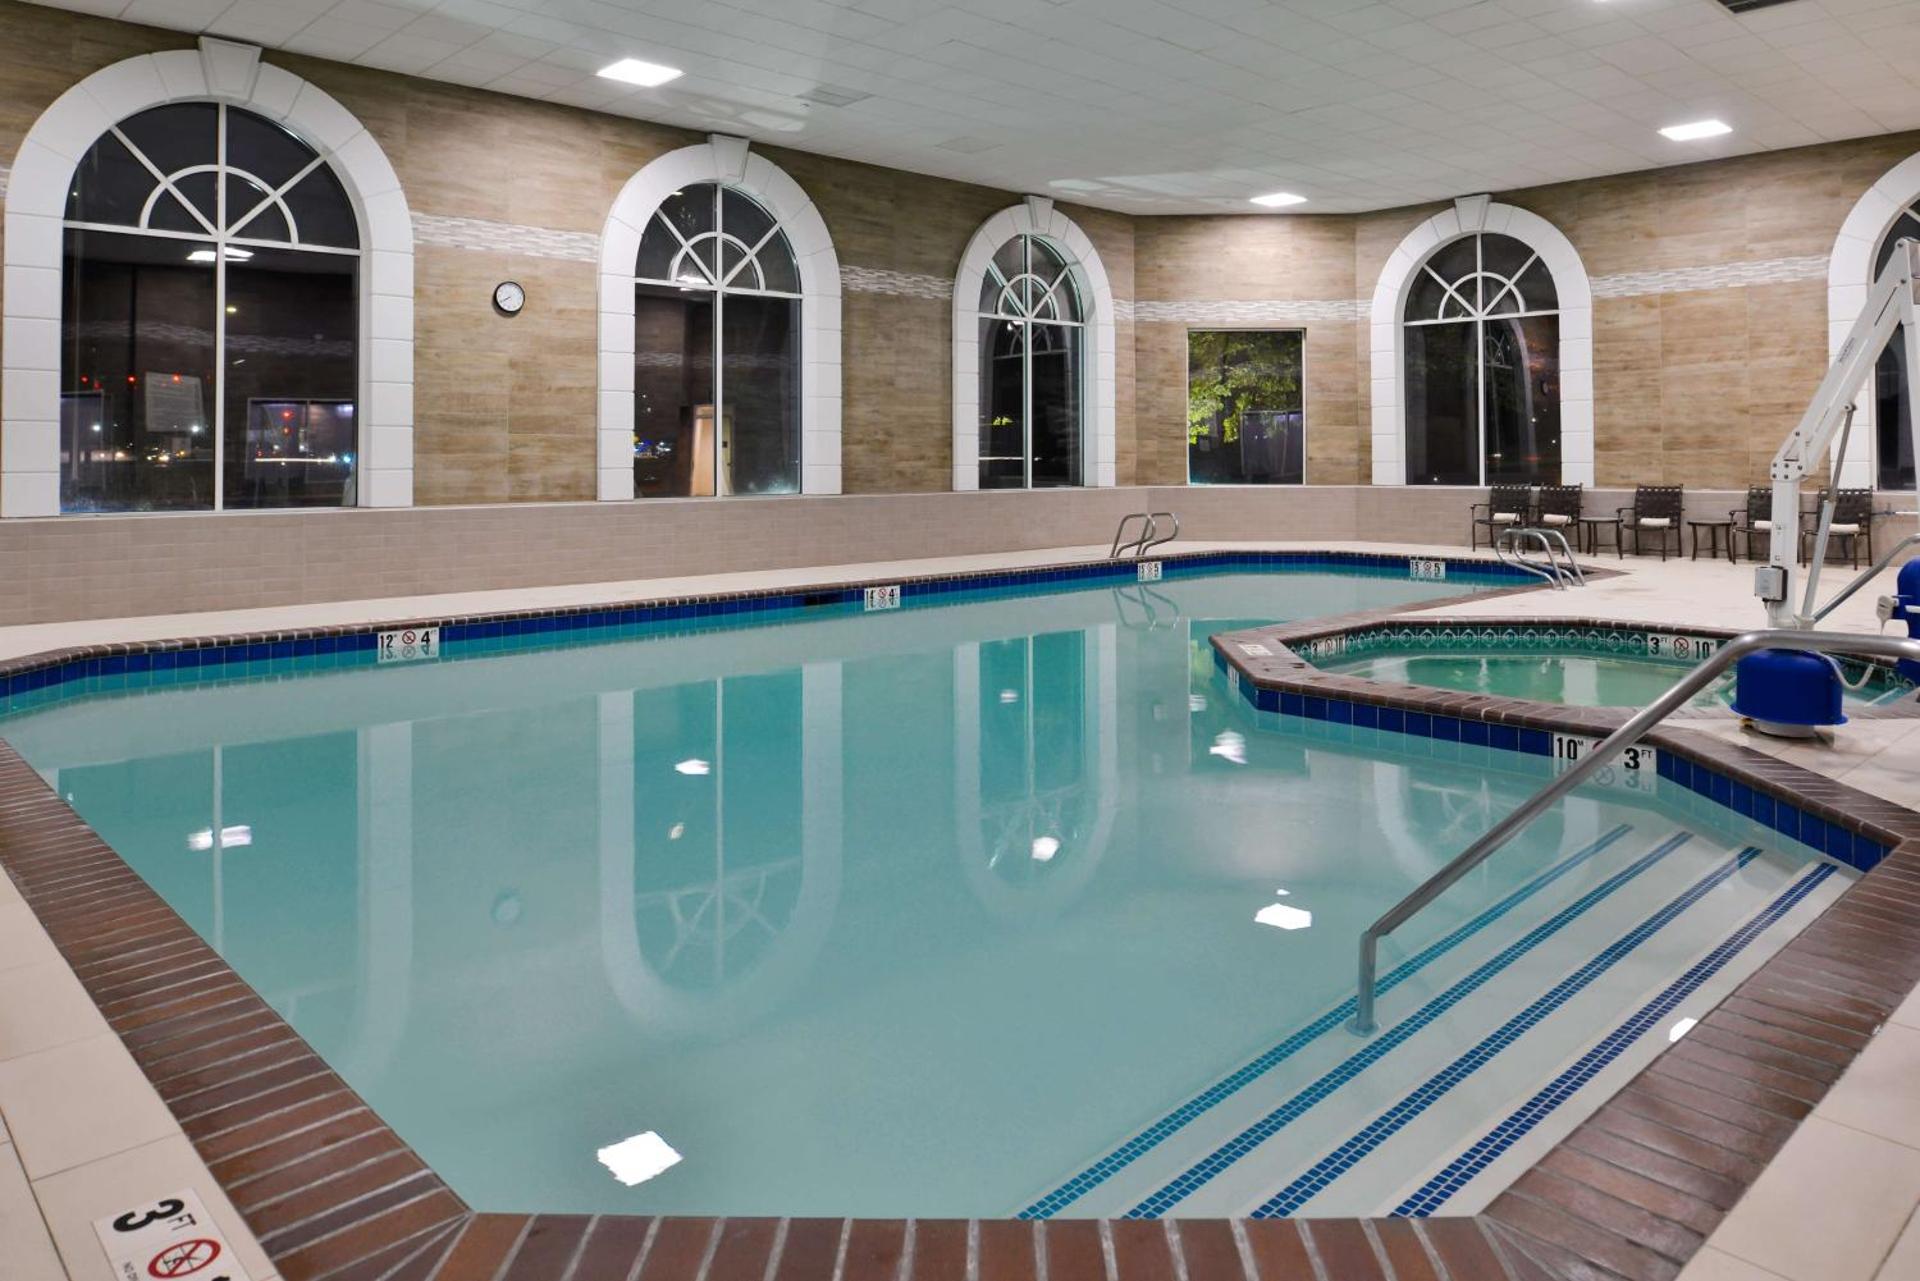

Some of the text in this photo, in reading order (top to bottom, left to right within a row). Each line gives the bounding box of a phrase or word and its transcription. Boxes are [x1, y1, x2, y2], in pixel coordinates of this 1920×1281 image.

[380, 630, 430, 648] 12 4
[1624, 747, 1640, 770] 3
[113, 1199, 185, 1232] 3
